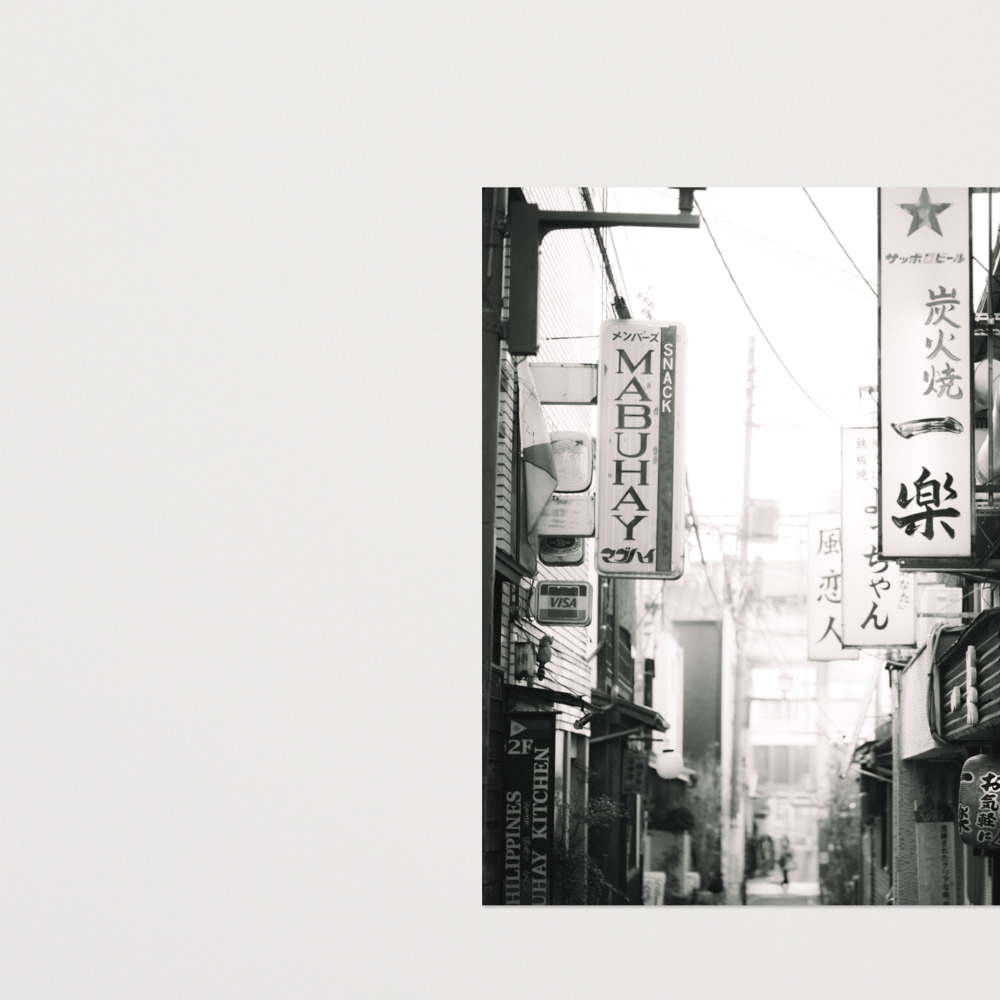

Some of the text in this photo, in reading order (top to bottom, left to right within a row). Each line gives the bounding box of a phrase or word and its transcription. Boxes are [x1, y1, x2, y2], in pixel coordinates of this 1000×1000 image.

[885, 252, 965, 264] サッポロビール
[612, 330, 660, 343] メンバーズ
[923, 285, 963, 400] 炭火焼
[661, 343, 674, 413] SNACK
[611, 348, 656, 541] MABUHAY
[891, 416, 964, 540] 一楽
[550, 597, 577, 608] VISA
[508, 739, 533, 755] 2F
[532, 747, 549, 840] KITCHEN
